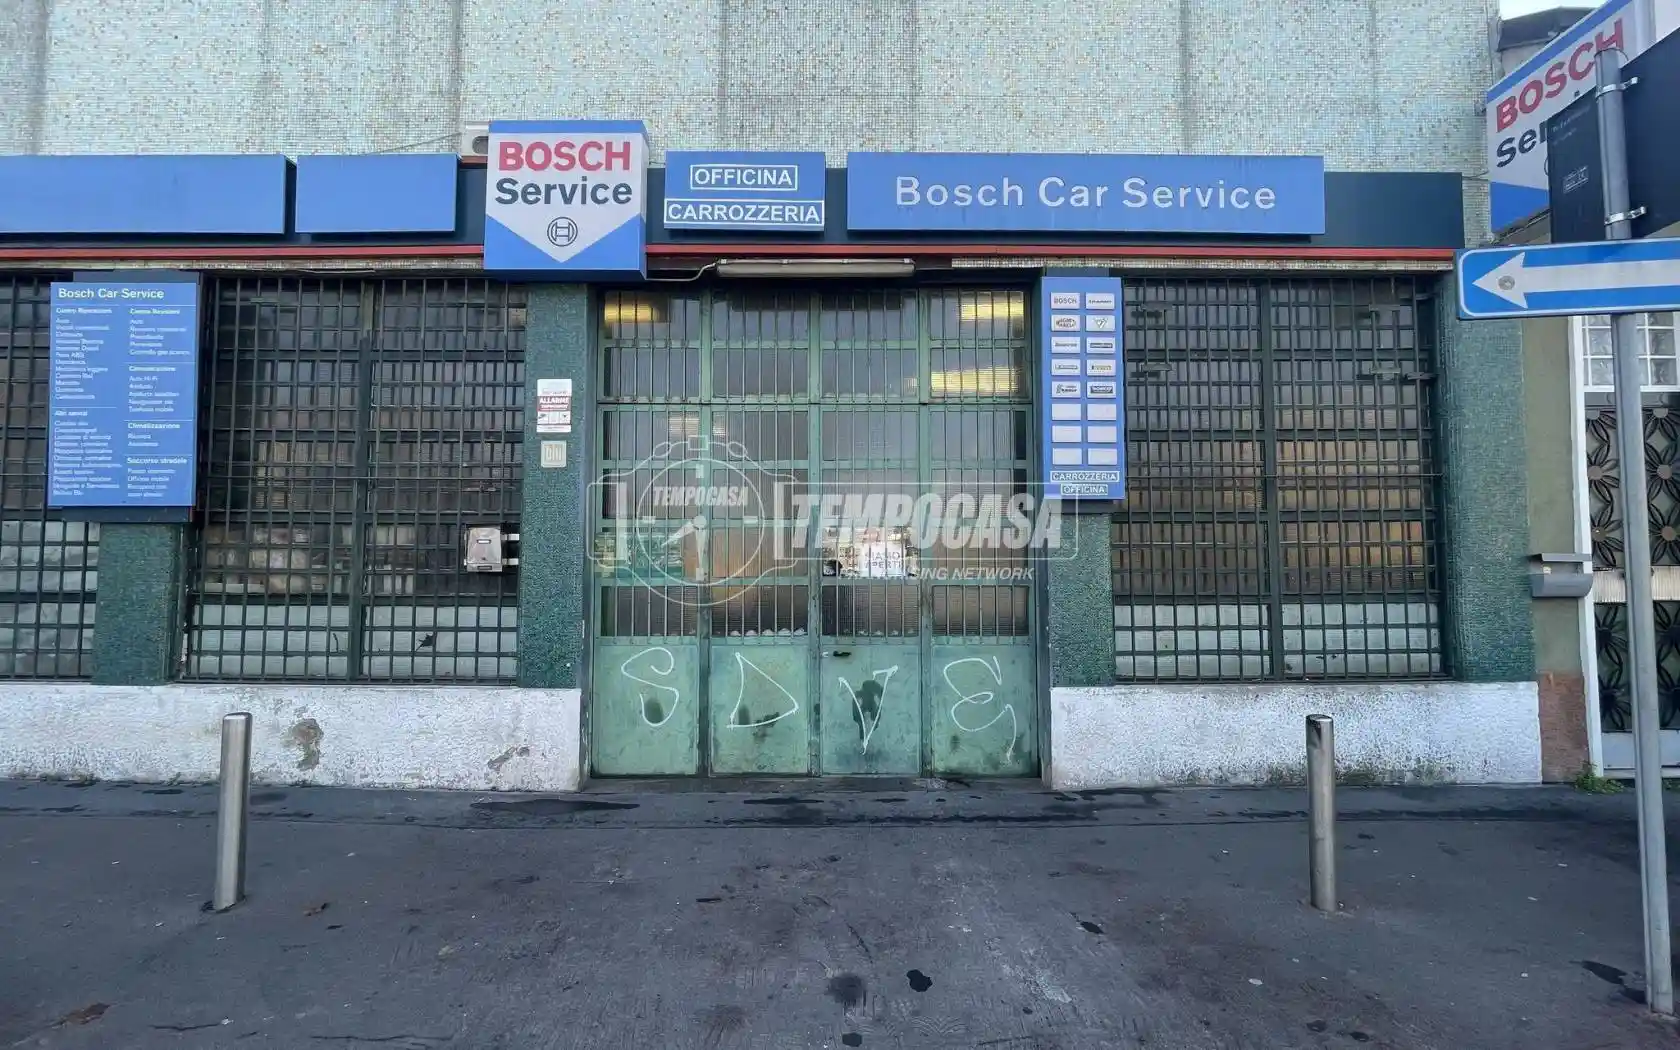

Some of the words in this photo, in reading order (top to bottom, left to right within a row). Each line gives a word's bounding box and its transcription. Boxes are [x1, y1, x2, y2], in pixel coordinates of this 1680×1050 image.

[1496, 18, 1624, 133] BOSCH
[498, 141, 631, 171] BOSCH
[694, 168, 793, 186] OFFICINA
[495, 176, 633, 205] Service
[896, 176, 1024, 207] Bosch
[1038, 176, 1109, 208] Car
[1121, 177, 1276, 209] Service
[667, 203, 820, 222] CARROZZERIA
[58, 287, 95, 299] Bosch
[97, 287, 118, 299] Car
[120, 287, 165, 299] Service
[1053, 296, 1077, 305] BOSCH
[1052, 472, 1117, 481] CARROZZERIA
[1063, 485, 1105, 494] OFFICINA
